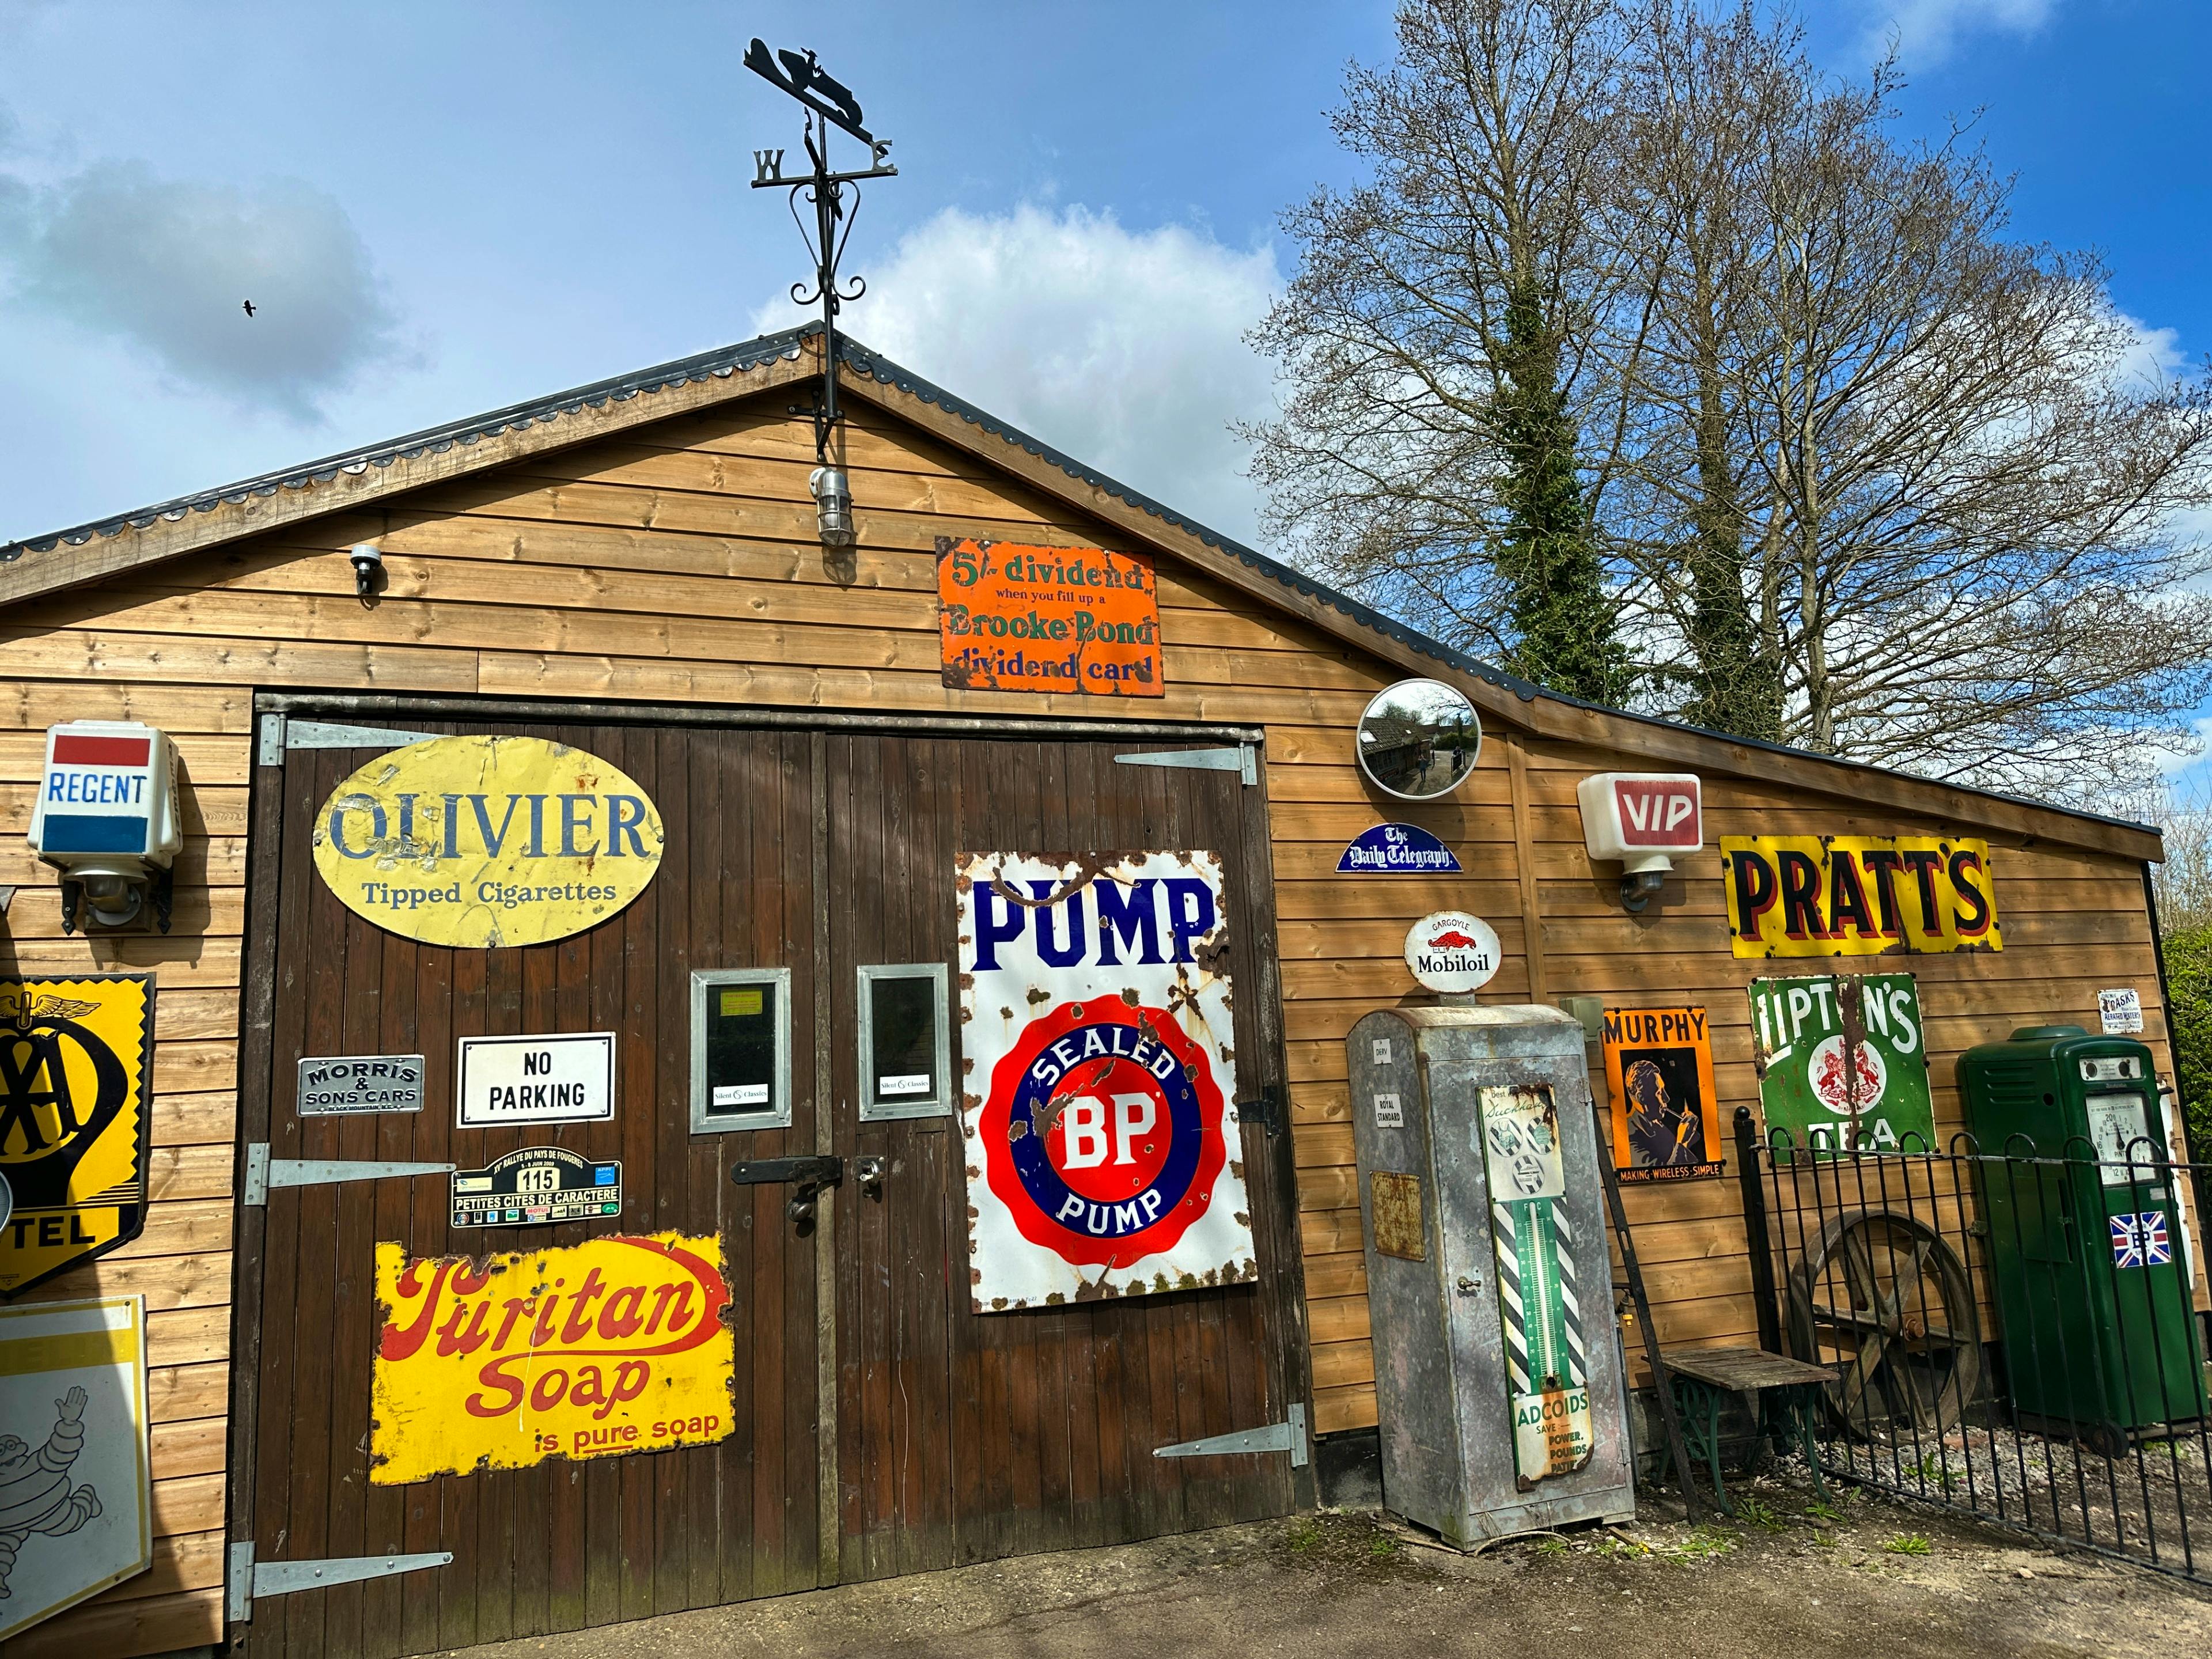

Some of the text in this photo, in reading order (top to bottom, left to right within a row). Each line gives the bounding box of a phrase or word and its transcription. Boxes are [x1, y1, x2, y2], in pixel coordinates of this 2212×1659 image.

[753, 149, 785, 180] W
[1005, 555, 1144, 589] dividend
[996, 588, 1027, 600] when
[1031, 591, 1054, 603] you
[1057, 590, 1074, 602] fill
[1079, 593, 1093, 606] up
[949, 604, 1153, 645] Brooke Bond
[954, 647, 1153, 683] dividend card
[48, 772, 147, 803] REGENT
[1622, 794, 1693, 831] VIP
[329, 793, 651, 859] OLIVIER
[1385, 827, 1408, 844] The
[1350, 844, 1453, 868] Daily Telegraph.
[361, 881, 617, 910] Tipped Cigarettes
[1730, 842, 1990, 942] PRATT'S
[970, 877, 1215, 972] PUMP
[1432, 919, 1470, 931] GARGOYLE
[1417, 953, 1490, 973] Mobiloil
[1604, 1010, 1706, 1044] MURPHY
[1757, 982, 1918, 1069] LIPTN'S
[524, 1052, 551, 1075] NO
[1032, 1027, 1176, 1086] SEALED
[1376, 1048, 1388, 1056] DERV
[306, 1062, 419, 1086] MORRIS
[355, 1076, 369, 1090] &
[306, 1088, 417, 1104] SONS CARS
[490, 1082, 585, 1110] PARKING
[1379, 1100, 1395, 1109] ROYAL
[1377, 1112, 1400, 1122] STANDARD
[2105, 1113, 2113, 1122] 20
[1062, 1092, 1157, 1171] BP
[2133, 1128, 2137, 1136] 4
[503, 1156, 524, 1169] RALLYE
[524, 1152, 533, 1161] DU
[534, 1150, 548, 1160] PAYS
[549, 1150, 556, 1159] DE
[557, 1152, 584, 1169] FOUGERES
[1620, 1164, 1719, 1181] MAKING WIRELESS SIMPLE
[523, 1169, 554, 1191] 115
[456, 1188, 618, 1210] PETITES CITES DE CARACTERE
[1055, 1188, 1162, 1234] PUMP
[1524, 1203, 1528, 1211] F
[1536, 1202, 1541, 1210] C
[8, 1215, 96, 1249] TEL
[380, 1256, 695, 1361] Puritan
[464, 1350, 651, 1420] Soap
[1517, 1392, 1589, 1427] ADCOIDS
[535, 1414, 719, 1455] is pure soap
[1550, 1444, 1587, 1459] POUNDS
